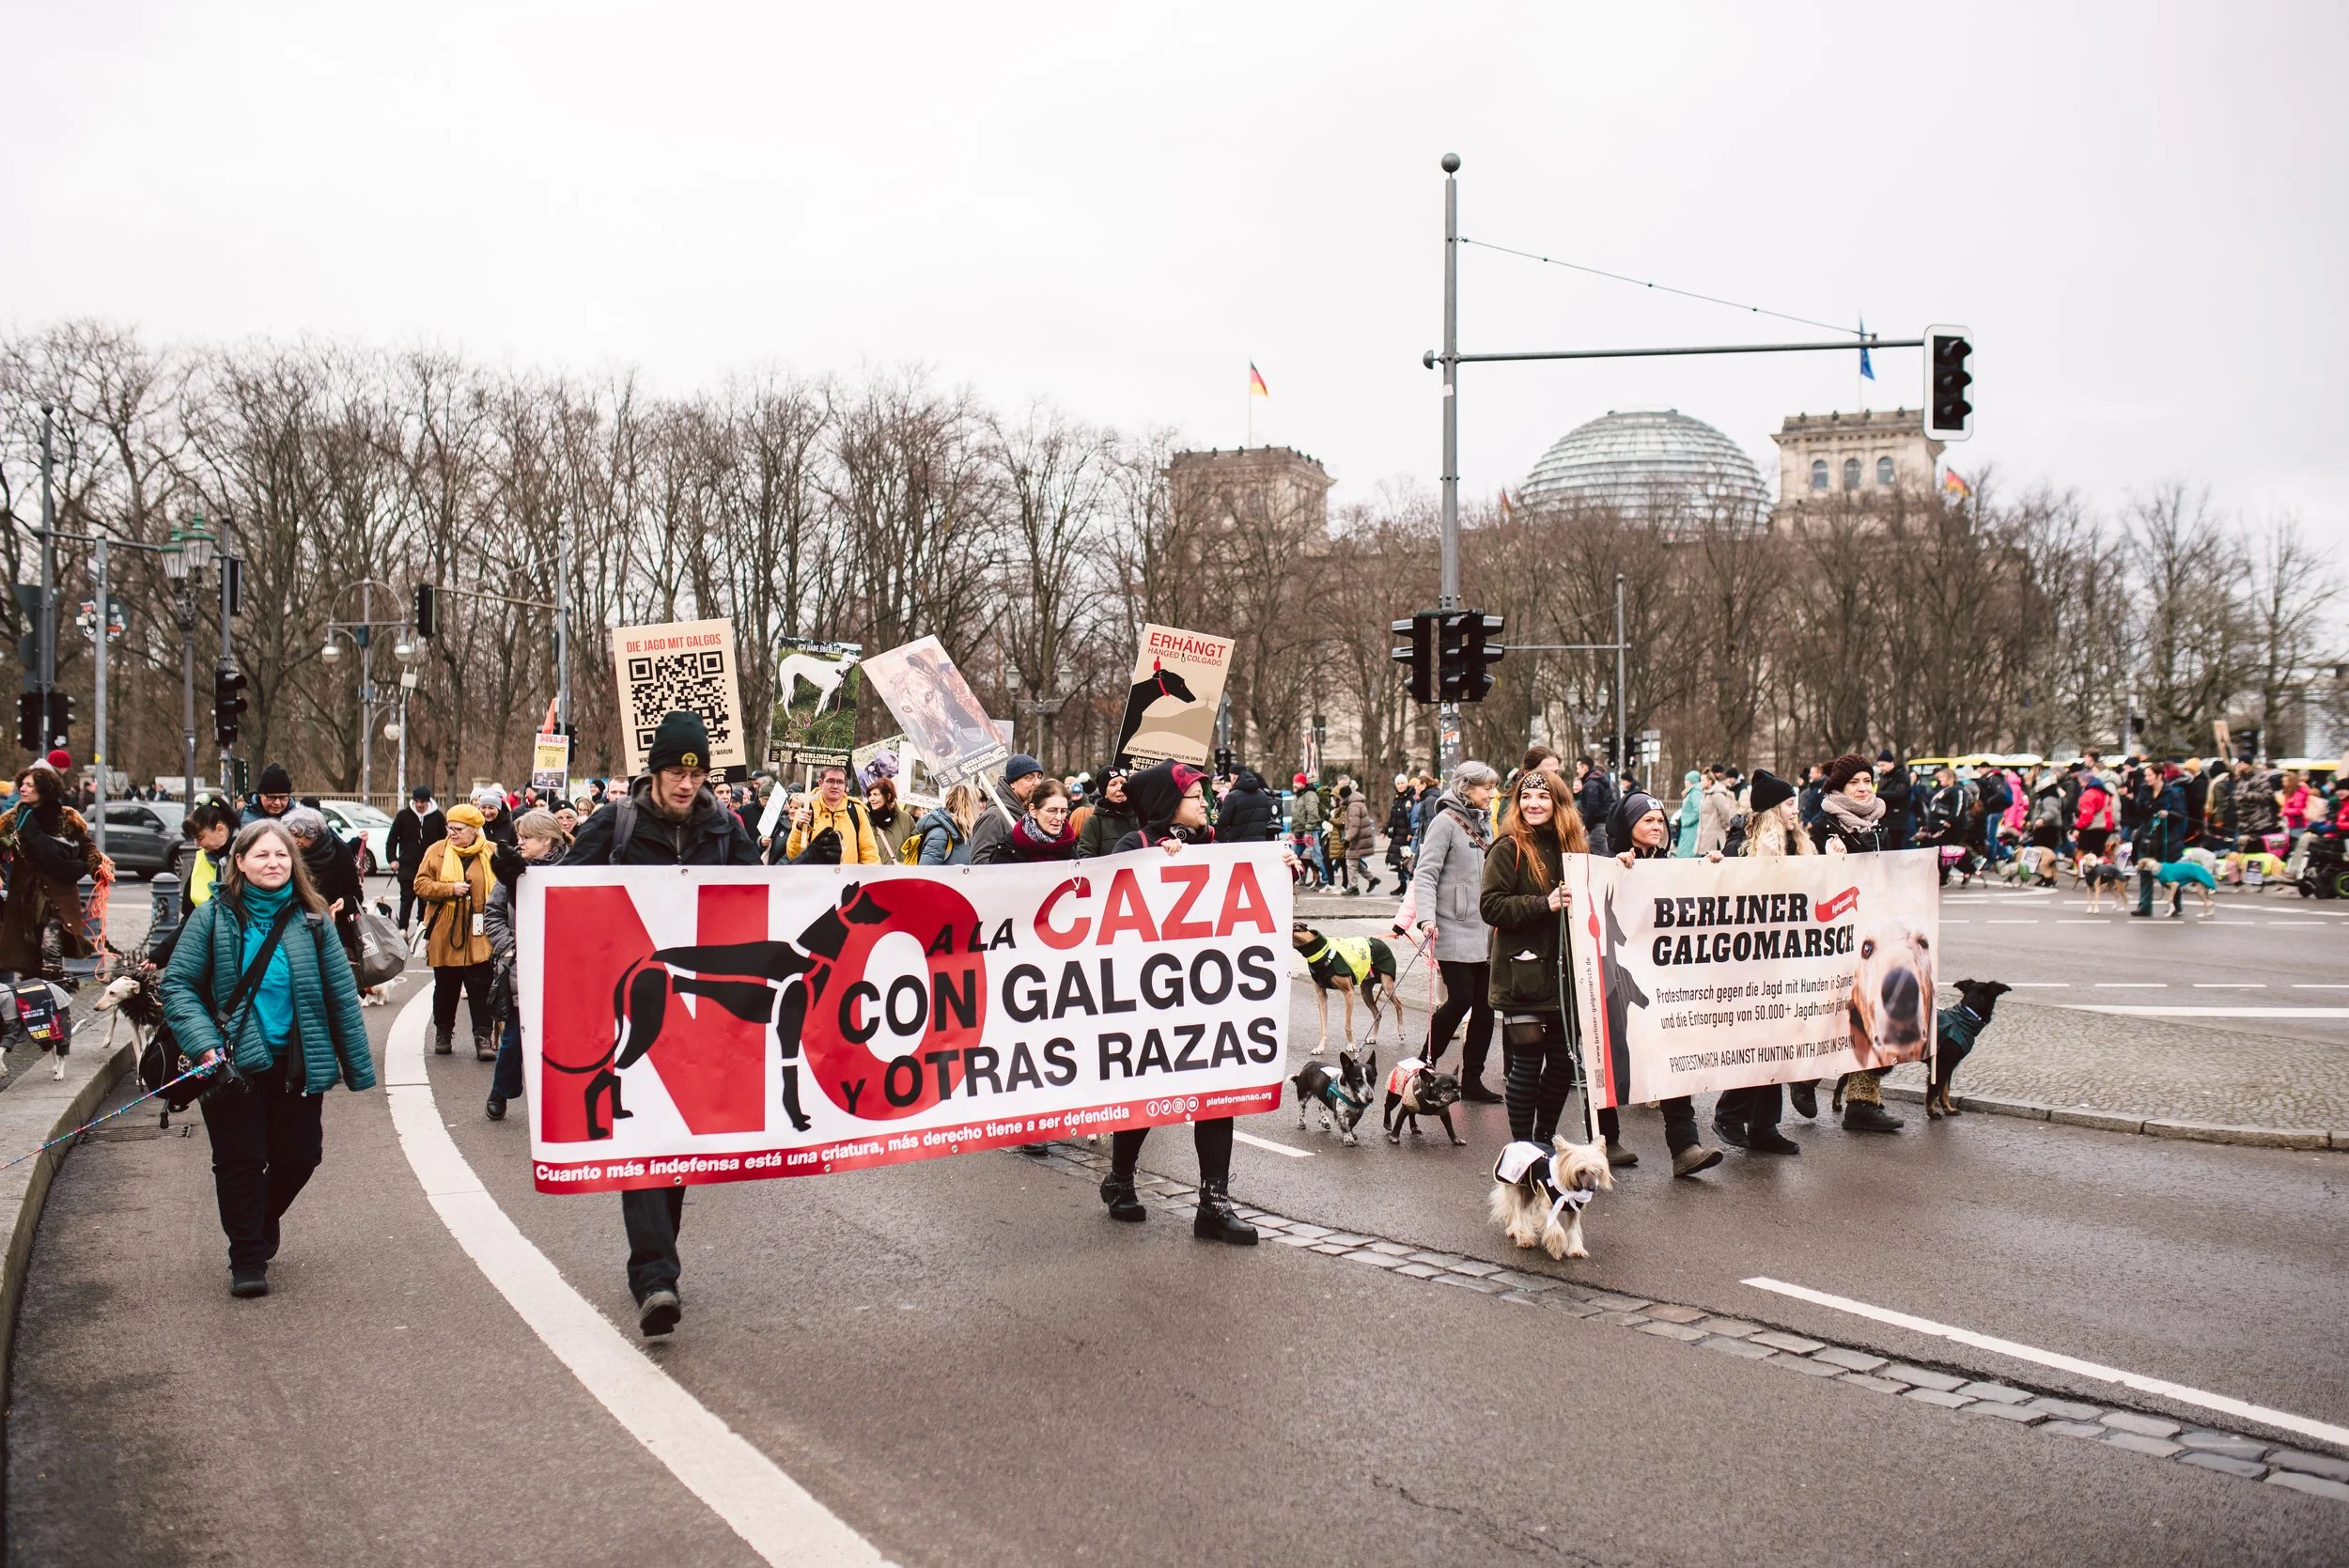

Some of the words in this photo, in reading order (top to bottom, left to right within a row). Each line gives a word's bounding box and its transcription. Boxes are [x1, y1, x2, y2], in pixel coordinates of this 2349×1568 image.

[626, 641, 641, 653] DIE
[644, 639, 665, 651] JAGD
[668, 637, 684, 648] MIT
[687, 633, 722, 647] GALGOS
[1147, 647, 1180, 660] HANGED
[1187, 654, 1222, 667] COLGADO
[1149, 632, 1226, 659] ERHÄNGT
[709, 748, 733, 756] E/WARUM
[800, 757, 847, 767] GALGOMARSCH
[925, 924, 954, 957] A
[967, 918, 1017, 953] LA
[1034, 862, 1277, 950] CAZA
[1654, 893, 1808, 928] BERLINER
[1652, 924, 1855, 967] GALGOMARSCH
[838, 969, 977, 1045] CON
[1001, 945, 1278, 1023] GALGOS
[1656, 984, 1715, 1003] Protestmarsch
[1717, 986, 1743, 1003] gegen
[1746, 982, 1759, 998] die
[1761, 980, 1782, 997] Jagd
[1785, 979, 1798, 994] mit
[1800, 976, 1828, 993] Hunden
[541, 878, 988, 1143] NO
[1586, 956, 1600, 1063] www.berliner-galgomarsch.de
[1660, 1013, 1674, 1030] und
[1676, 1012, 1688, 1027] die
[1689, 1010, 1734, 1029] Entsorgung
[1736, 1009, 1752, 1022] von
[1754, 1003, 1792, 1020] 50.000+
[1794, 1001, 1835, 1021] Jagdhunden
[841, 1079, 865, 1114] Y
[883, 1037, 1078, 1108] OTRAS
[1097, 1017, 1278, 1080] RAZAS
[1669, 1053, 1719, 1074] PROTESTMARCH
[1720, 1048, 1756, 1067] AGAINST
[1758, 1043, 1794, 1063] HUNTING
[1796, 1040, 1815, 1059] WITH
[1837, 1033, 1856, 1052] SPAIN
[536, 1164, 601, 1182] Cuanto
[606, 1157, 645, 1178] más
[649, 1157, 739, 1175] indefensa
[744, 1151, 781, 1170] está
[787, 1151, 817, 1166] una
[820, 1141, 884, 1161] criatura,
[888, 1133, 918, 1152] más
[923, 1126, 982, 1146] derecho
[986, 1120, 1022, 1138] tiene
[1026, 1120, 1034, 1132] a
[1038, 1115, 1060, 1130] ser
[1064, 1105, 1129, 1127] defendida
